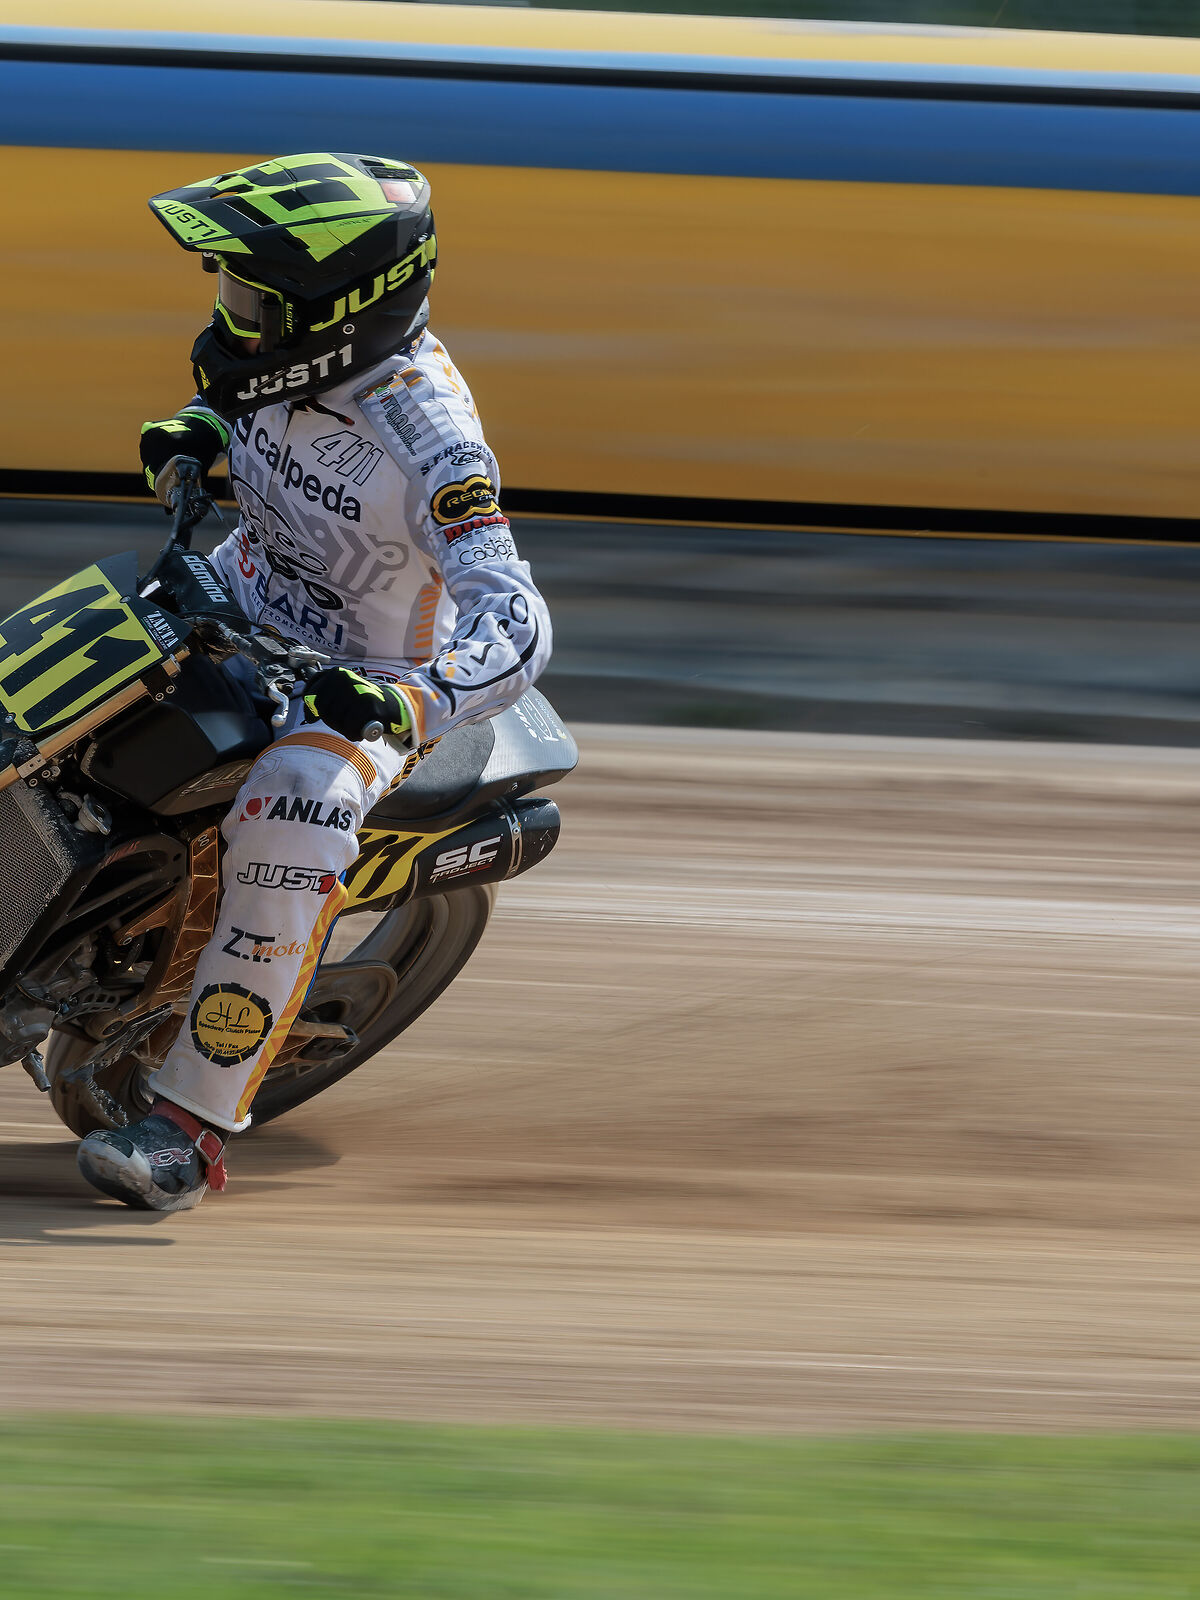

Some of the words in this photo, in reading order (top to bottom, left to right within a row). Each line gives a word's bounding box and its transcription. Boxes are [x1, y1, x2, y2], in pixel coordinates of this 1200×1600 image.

[159, 202, 218, 239] JUST1
[237, 343, 353, 400] JUST1
[311, 430, 384, 486] 411
[182, 555, 229, 603] domino
[267, 796, 352, 831] ANLAS
[433, 836, 501, 874] SC
[237, 862, 337, 895] JUST1
[252, 940, 309, 957] moto
